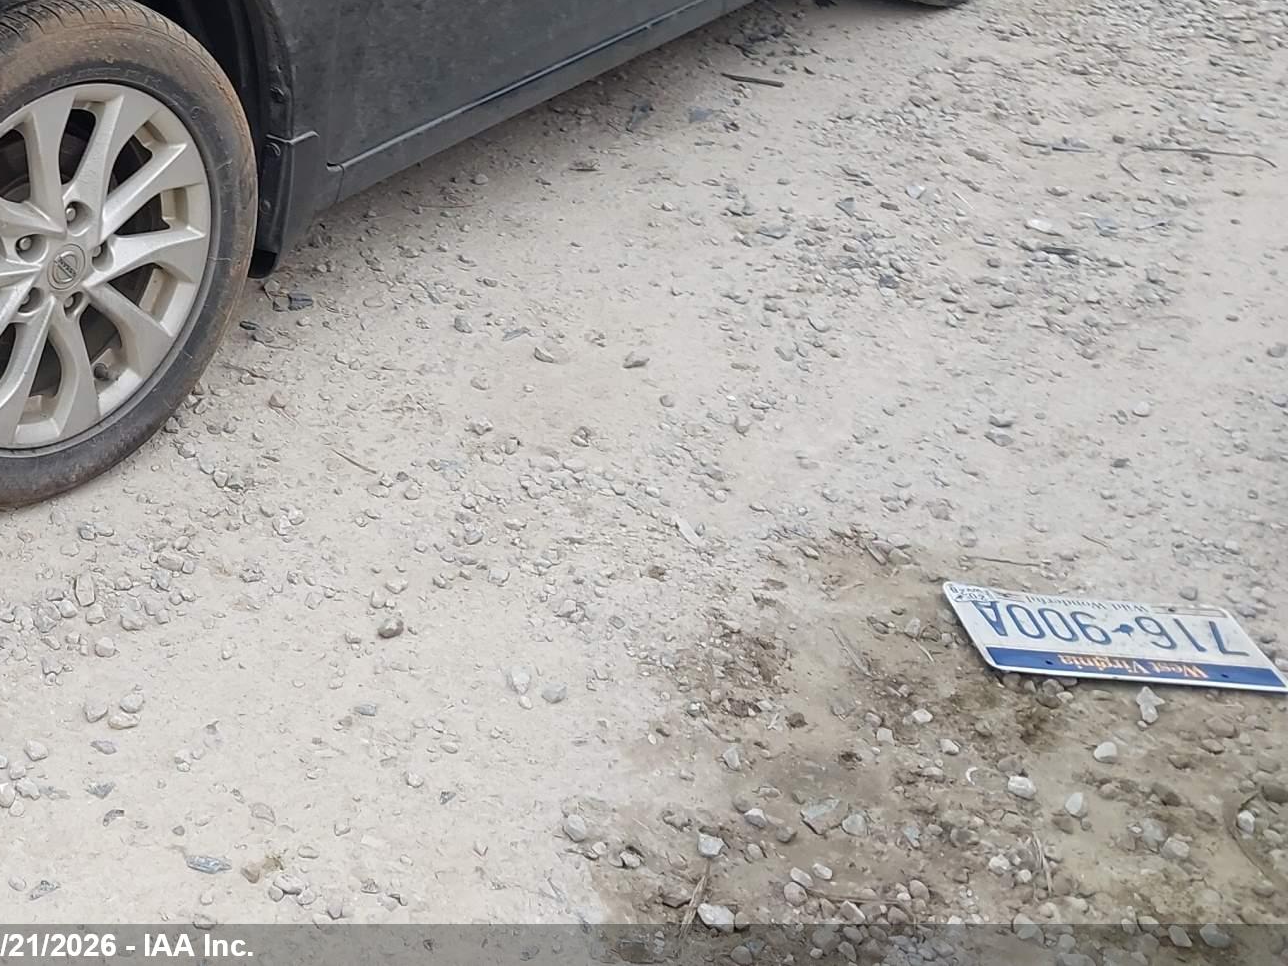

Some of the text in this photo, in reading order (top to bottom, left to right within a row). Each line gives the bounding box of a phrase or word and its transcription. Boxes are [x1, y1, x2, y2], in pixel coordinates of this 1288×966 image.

[1025, 595, 1149, 613] Wild Wonderful
[1057, 654, 1209, 679] West Virginia
